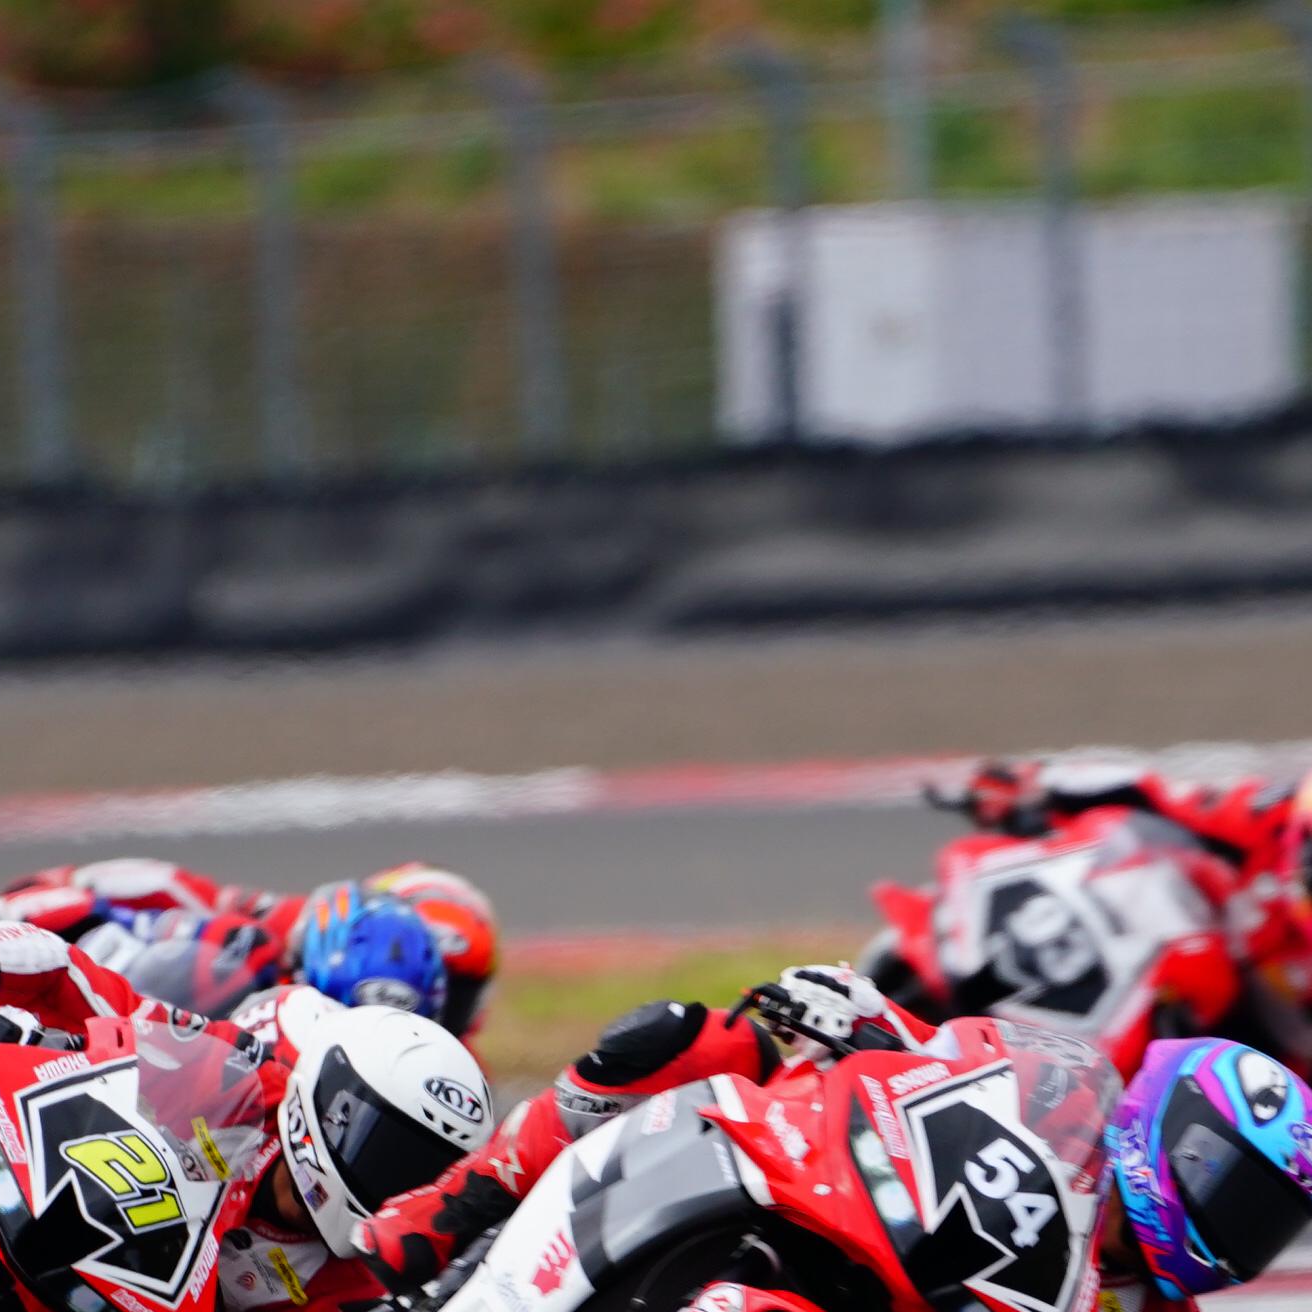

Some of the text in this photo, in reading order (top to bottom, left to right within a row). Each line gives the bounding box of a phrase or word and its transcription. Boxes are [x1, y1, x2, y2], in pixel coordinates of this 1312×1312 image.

[33, 1052, 91, 1082] SHOWA
[424, 1076, 484, 1119] KYT
[60, 1130, 186, 1234] 21
[964, 1138, 1058, 1248] 54
